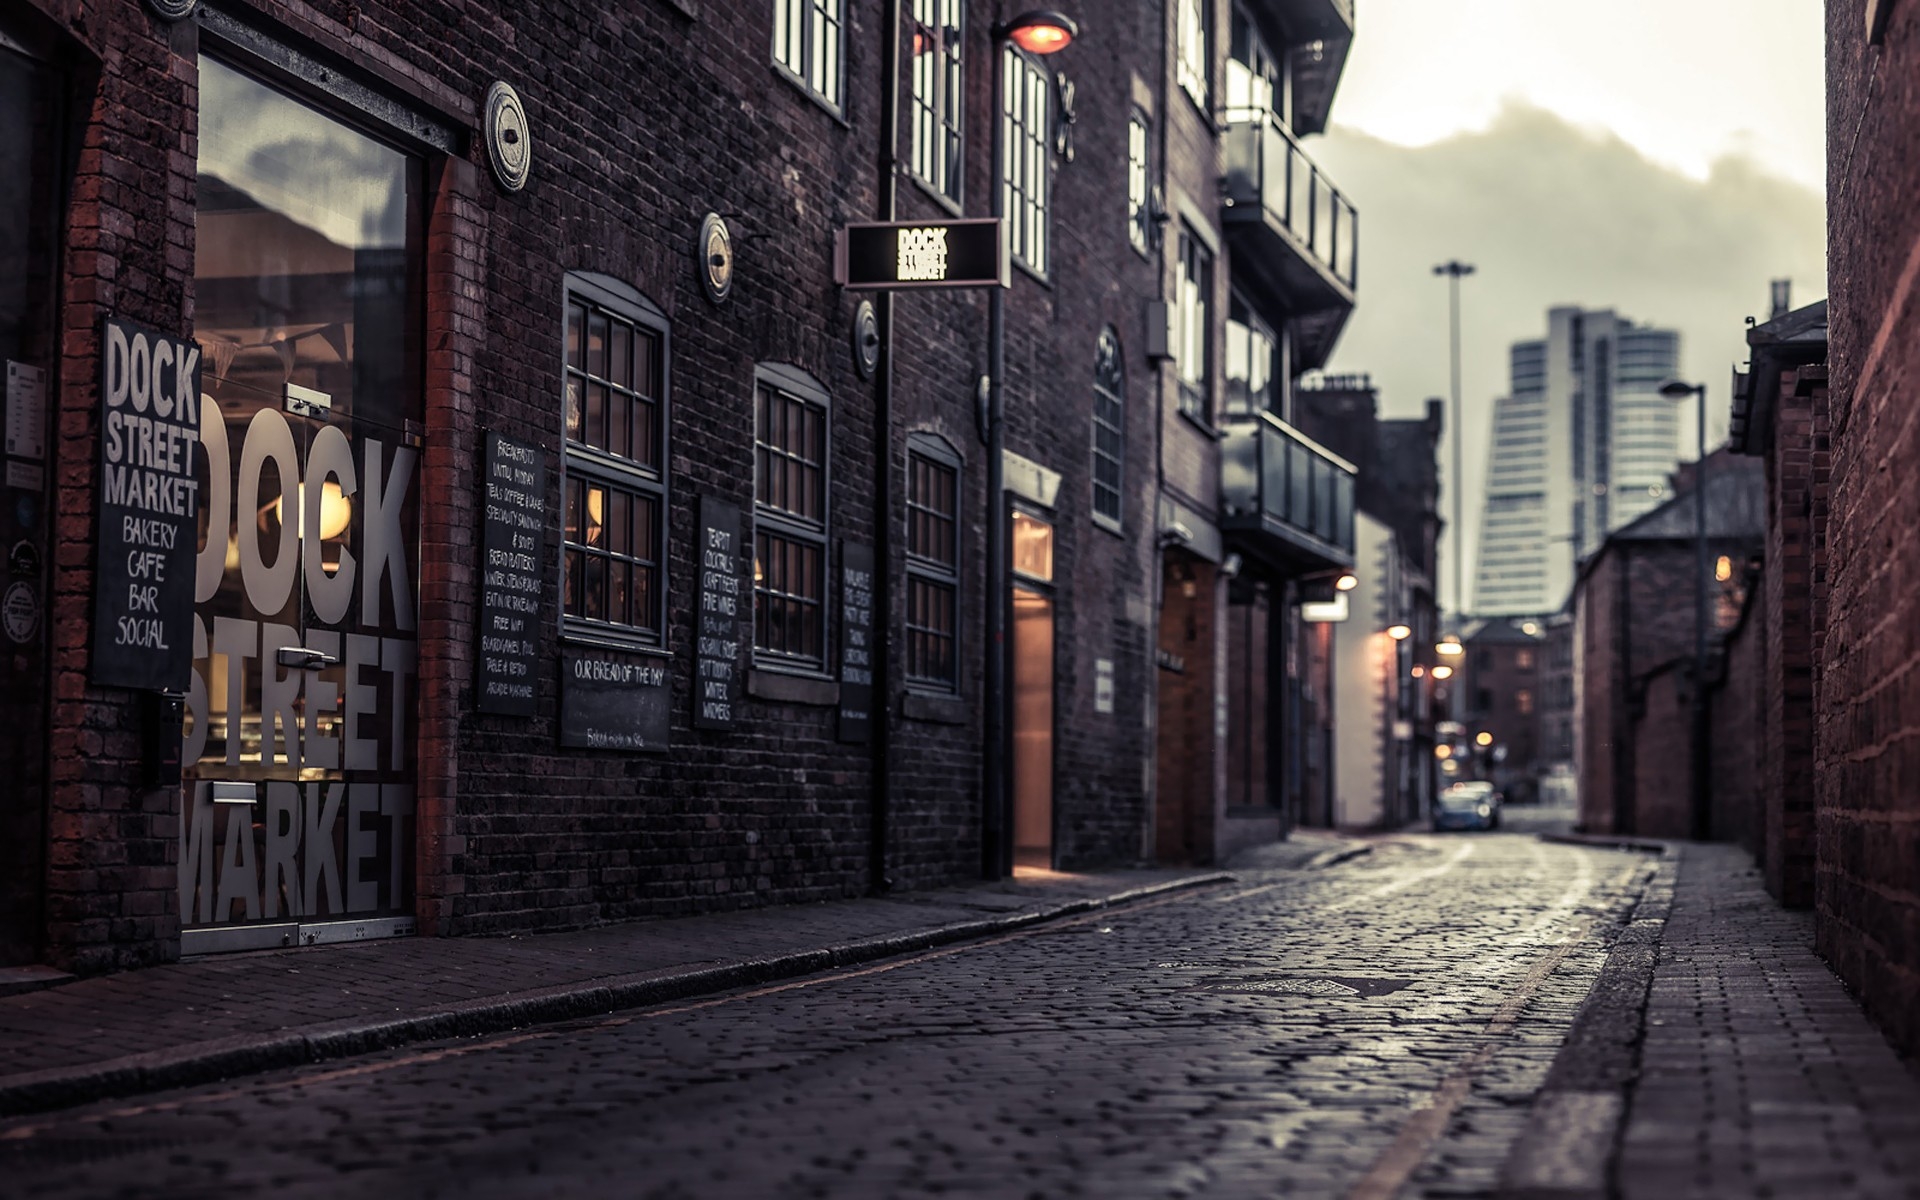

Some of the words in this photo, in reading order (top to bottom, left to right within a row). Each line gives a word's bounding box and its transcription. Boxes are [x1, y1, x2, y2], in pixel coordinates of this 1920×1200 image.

[107, 323, 199, 424] DOCK
[106, 410, 199, 476] STREET
[104, 463, 198, 517] MARKET
[195, 392, 417, 631] DOCK
[123, 516, 178, 549] BAKERY
[127, 550, 166, 582] CAFE
[129, 584, 158, 613] BAR
[115, 616, 169, 649] SOCIAL
[493, 616, 509, 630] FREE
[575, 659, 592, 680] OUR
[593, 660, 620, 681] BREAD
[622, 664, 633, 682] OF
[634, 665, 650, 684] THE
[650, 667, 664, 686] DAY
